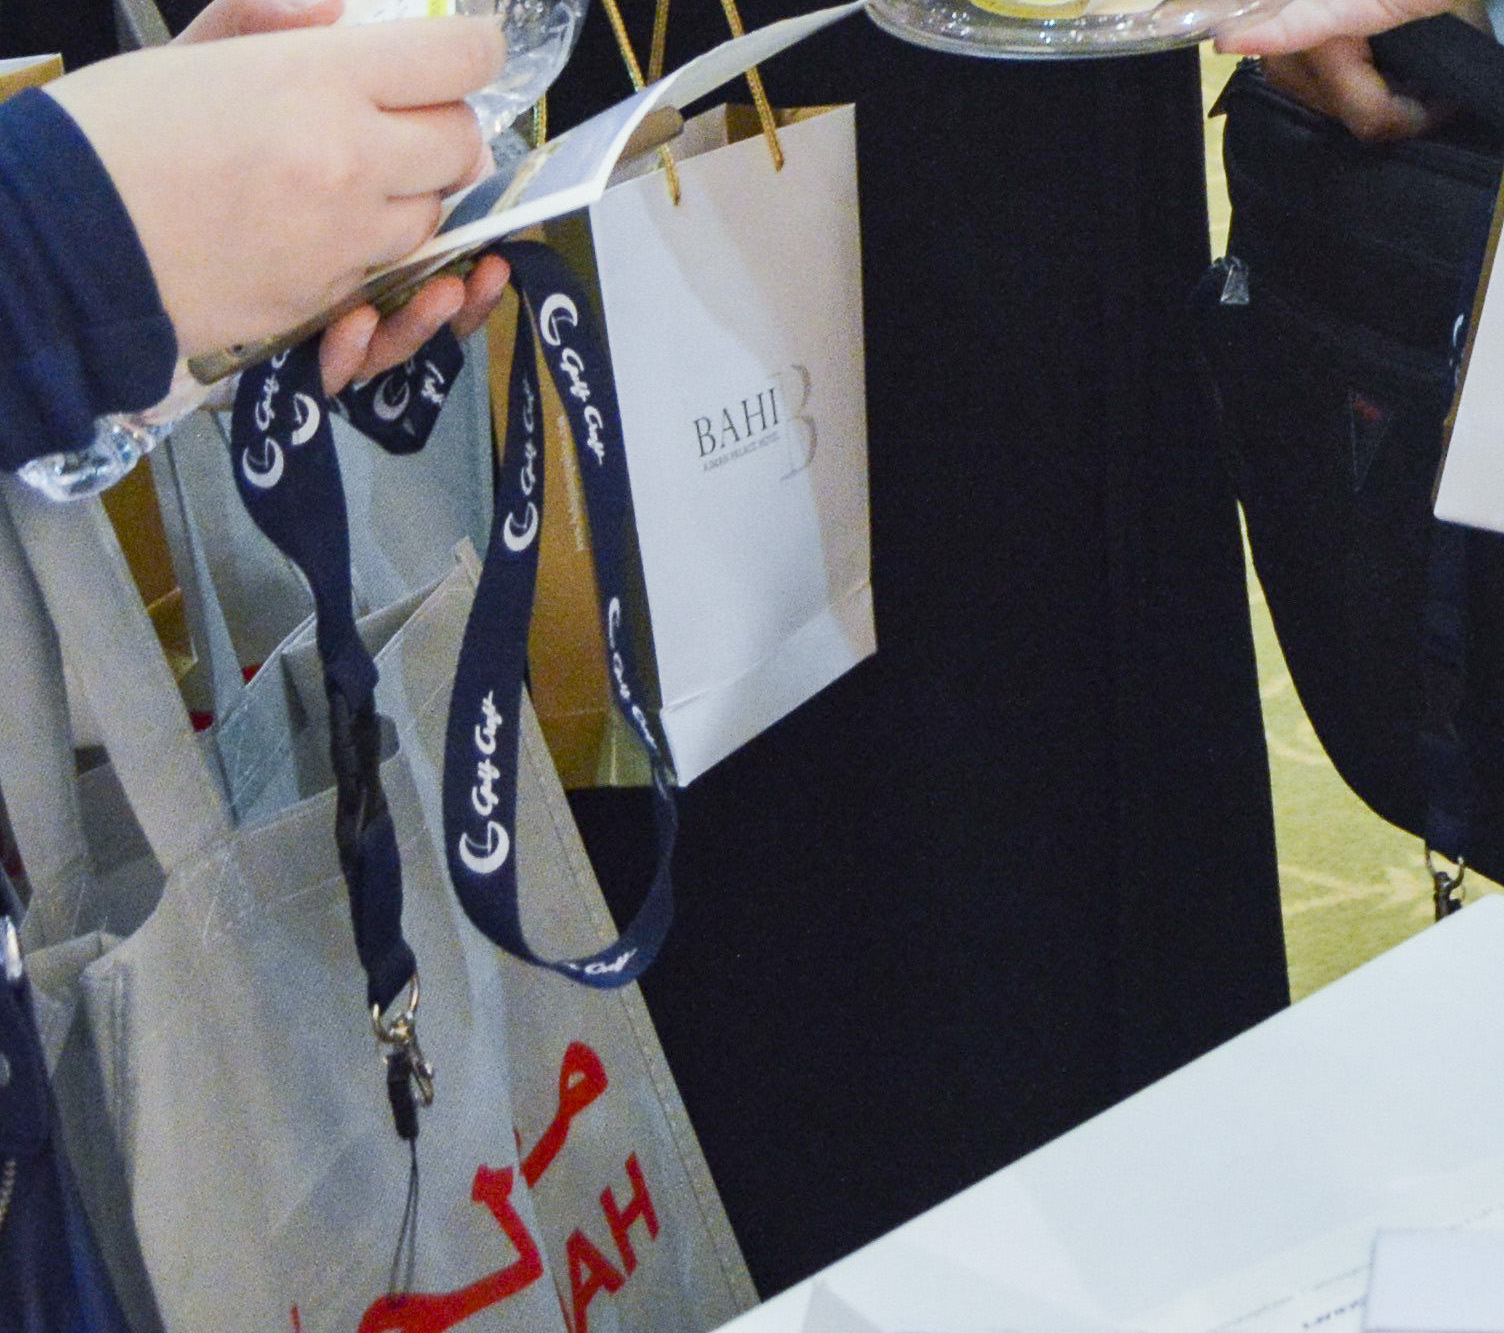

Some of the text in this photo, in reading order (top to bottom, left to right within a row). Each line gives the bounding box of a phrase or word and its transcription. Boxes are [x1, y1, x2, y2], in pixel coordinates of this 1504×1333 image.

[254, 374, 279, 431] Gulf
[562, 348, 590, 403] Gulf
[583, 405, 605, 466] Craft
[693, 387, 779, 458] BAHI
[472, 690, 504, 817] Gulf Craft
